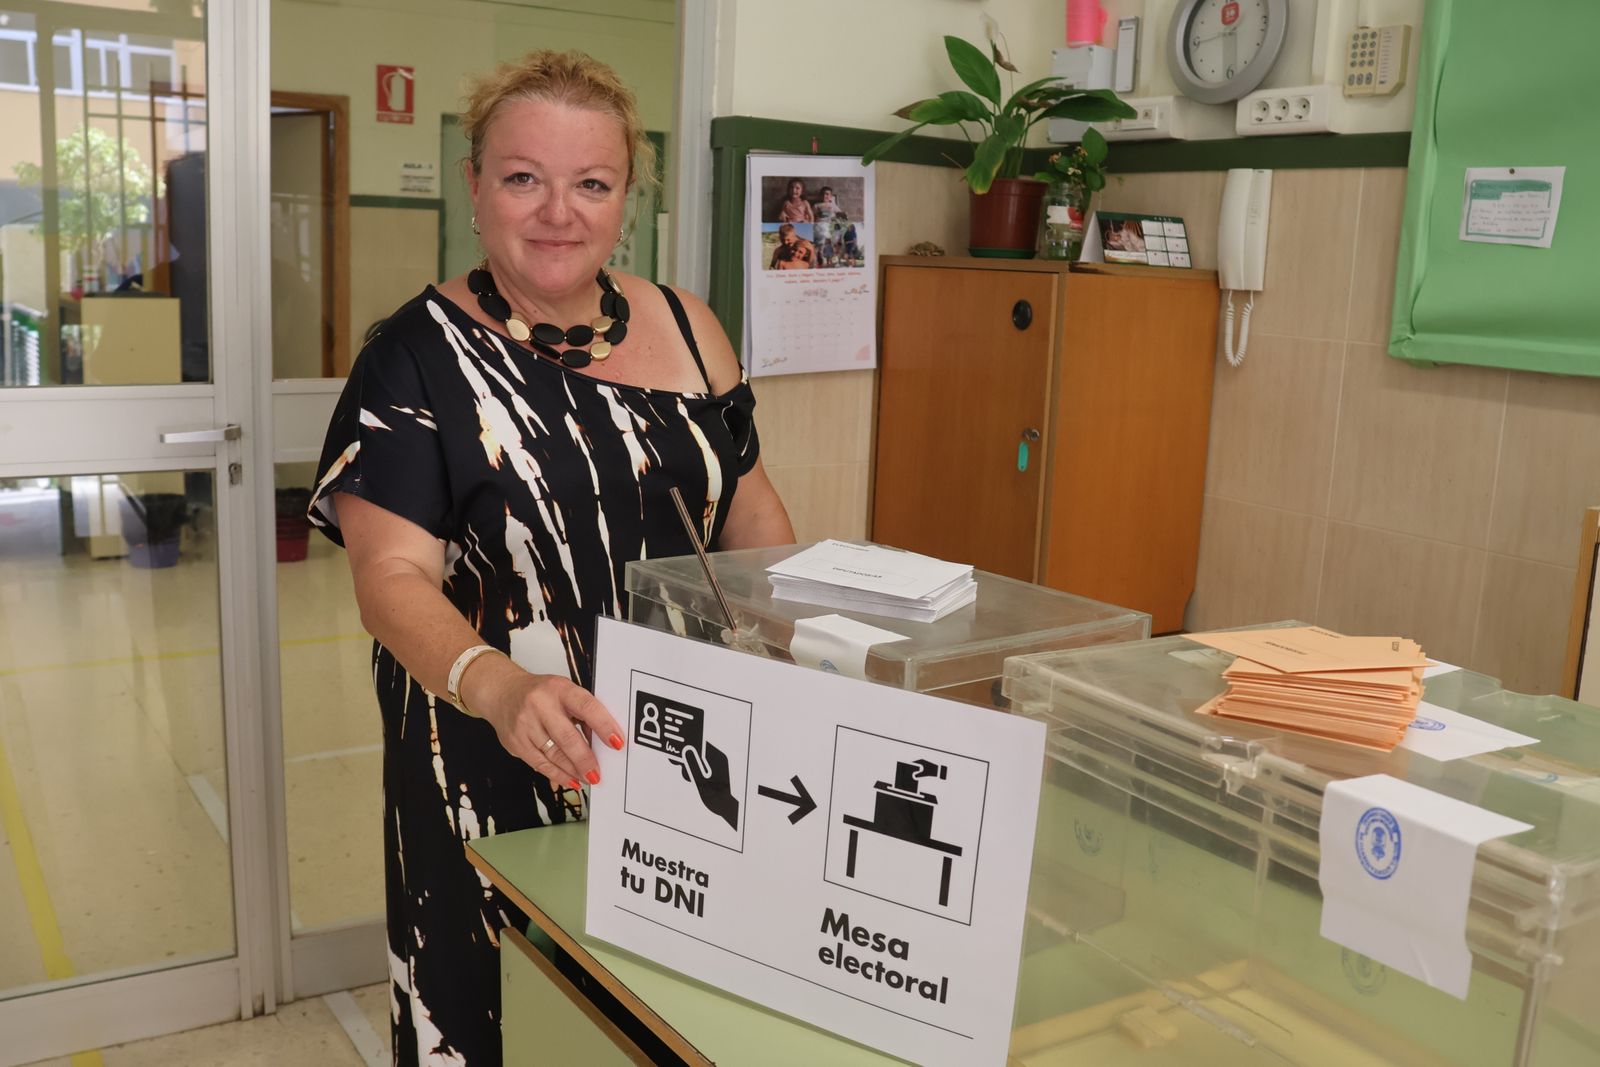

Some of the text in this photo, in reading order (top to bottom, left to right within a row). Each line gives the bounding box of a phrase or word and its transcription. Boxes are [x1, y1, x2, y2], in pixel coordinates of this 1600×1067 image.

[621, 838, 709, 889] Muestra
[620, 866, 705, 918] tu DNI
[820, 907, 910, 961] Mesa
[818, 943, 949, 1005] electoral
